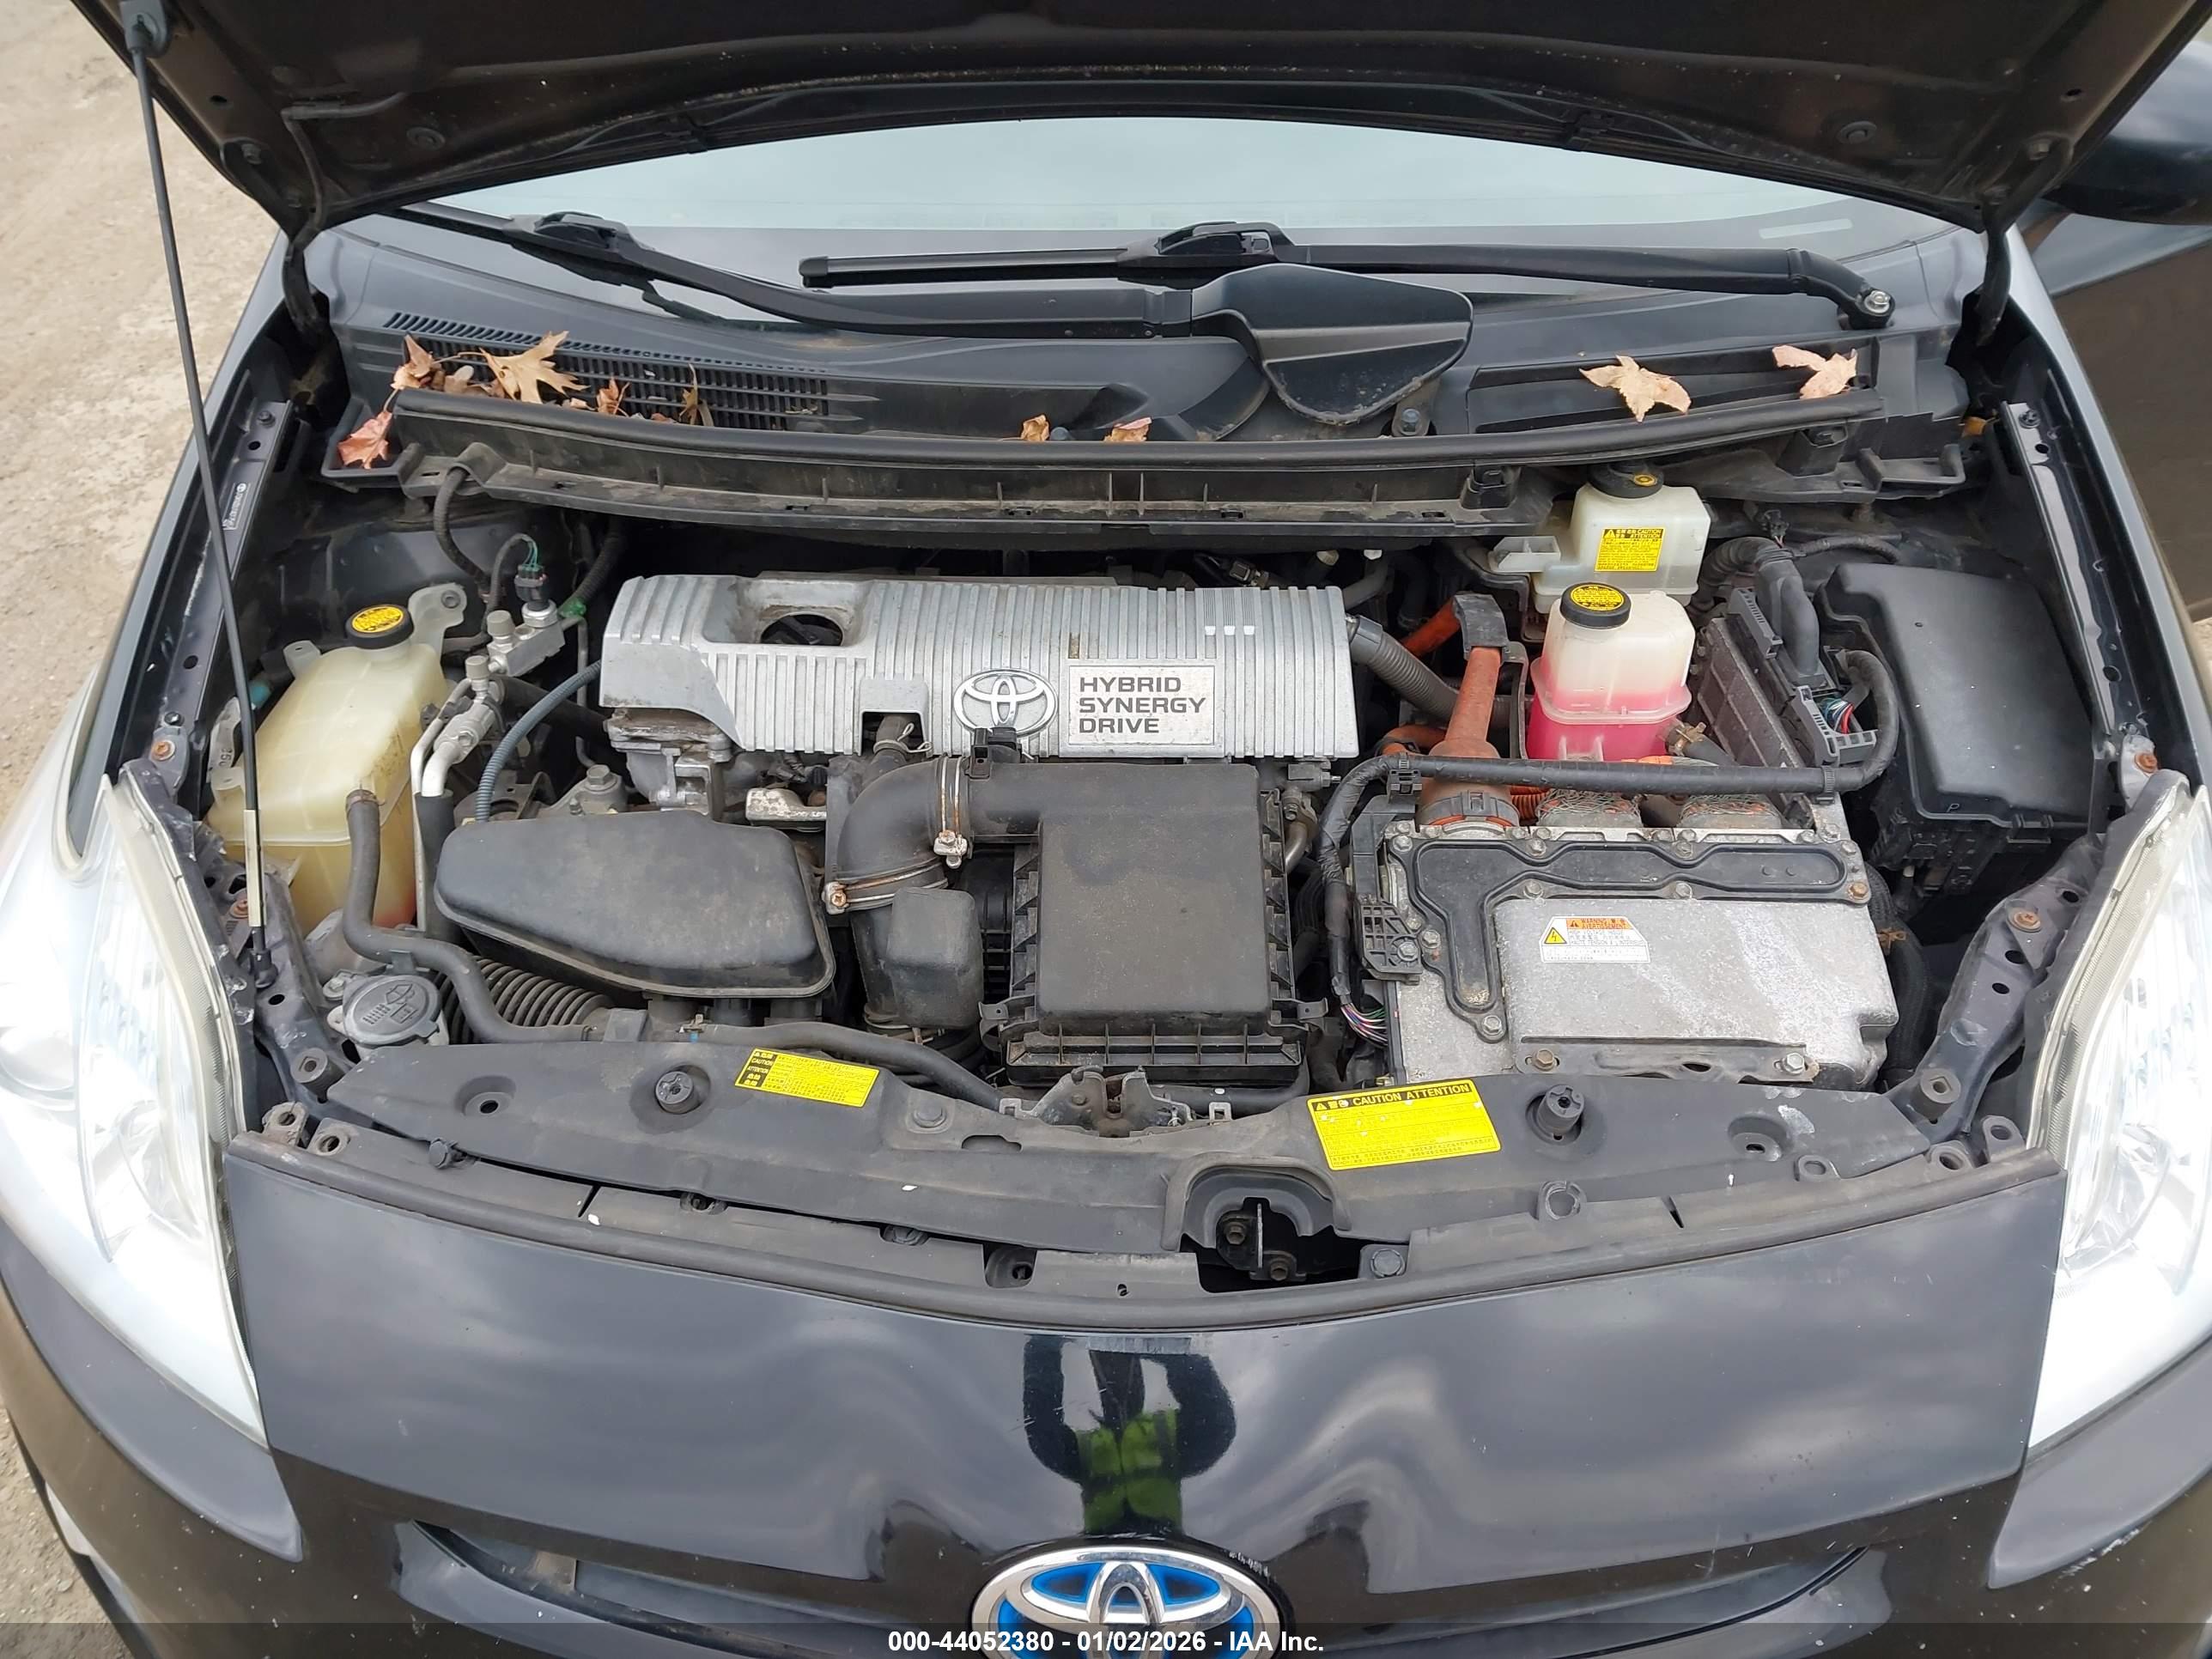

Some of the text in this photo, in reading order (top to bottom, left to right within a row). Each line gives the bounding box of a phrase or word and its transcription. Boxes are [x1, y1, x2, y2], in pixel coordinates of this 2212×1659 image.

[1079, 677, 1182, 692] HYBRID
[1079, 697, 1206, 714] SYNERGY
[1079, 718, 1160, 733] DRIVE
[751, 1057, 775, 1066] CAUTION
[746, 1066, 769, 1074] ATTENTION
[1352, 1092, 1402, 1106] CAUTION
[1407, 1084, 1470, 1100] ATTENTION
